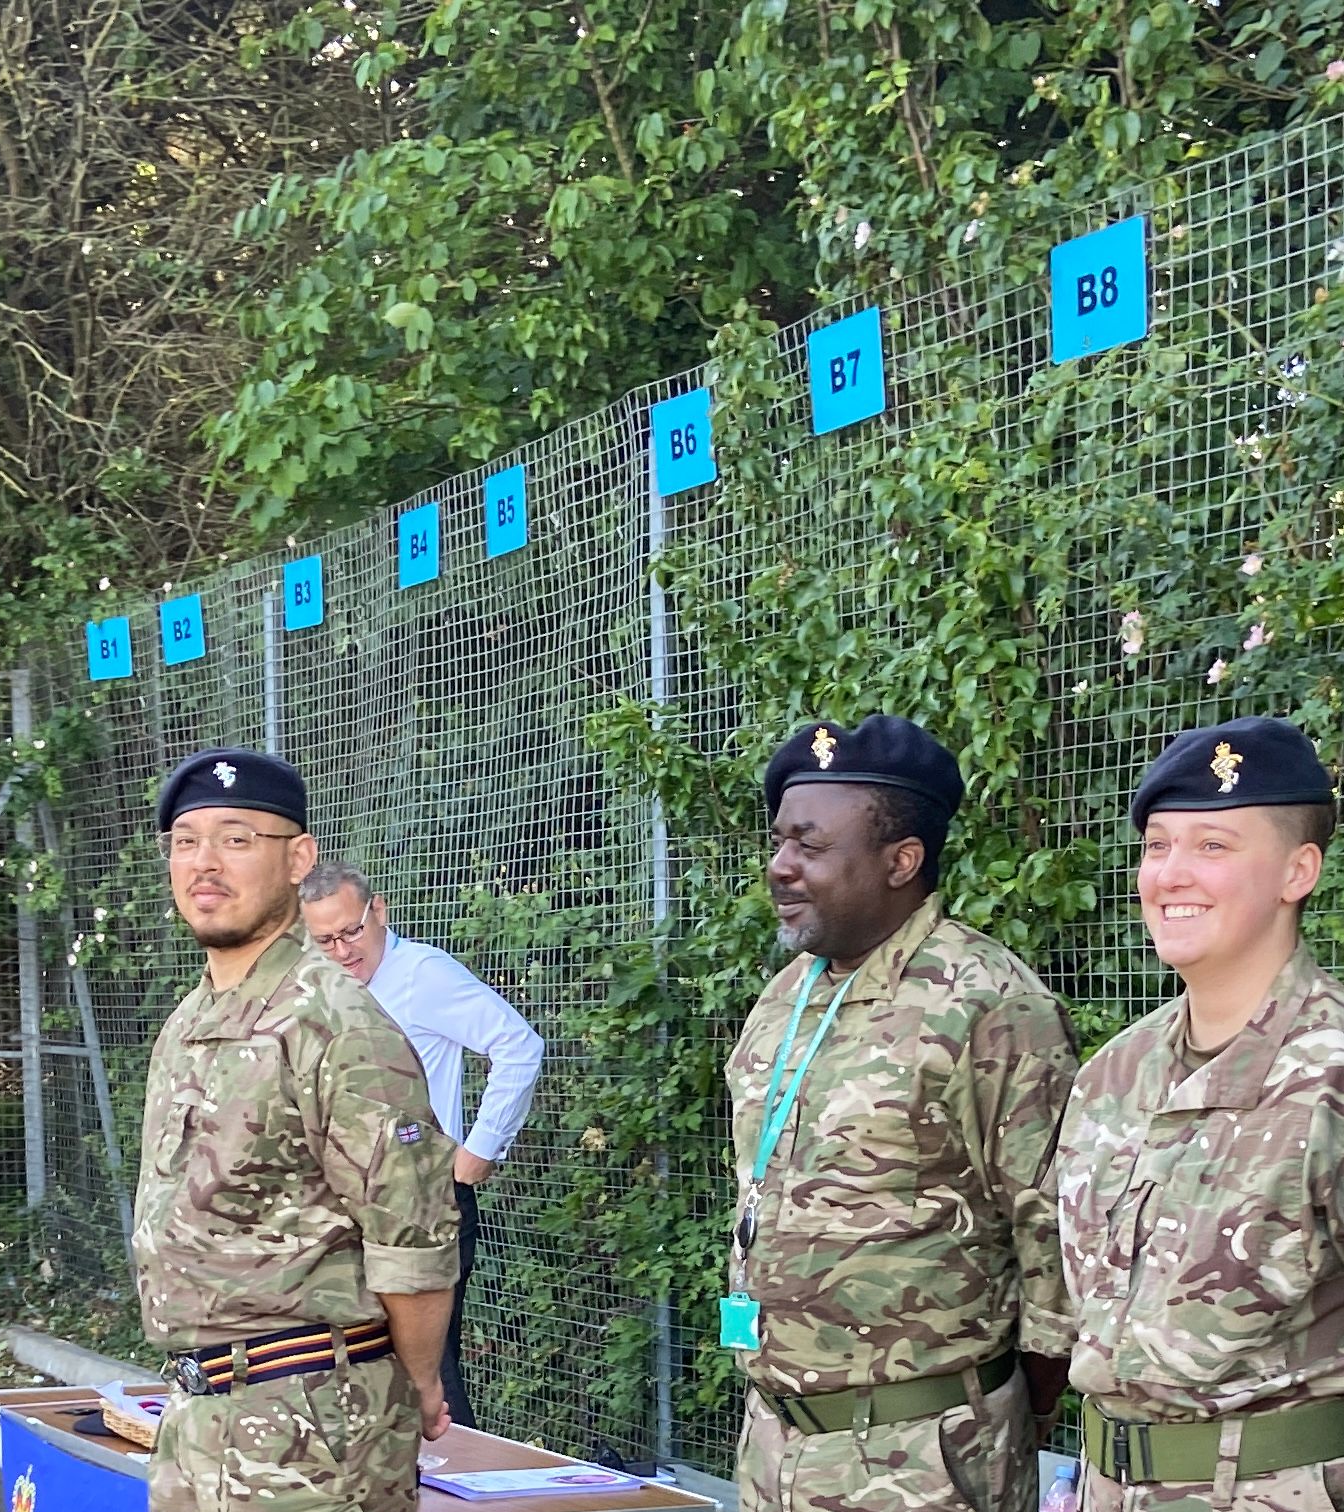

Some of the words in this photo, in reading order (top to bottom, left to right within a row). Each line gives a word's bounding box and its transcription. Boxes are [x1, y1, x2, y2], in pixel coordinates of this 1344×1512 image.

[1077, 266, 1118, 316] B8
[830, 349, 862, 394] B7
[670, 423, 697, 461] B6
[497, 495, 516, 527] B5
[410, 530, 429, 560] B4
[294, 580, 312, 606] B3
[173, 617, 192, 643] B2
[100, 638, 118, 660] B1
